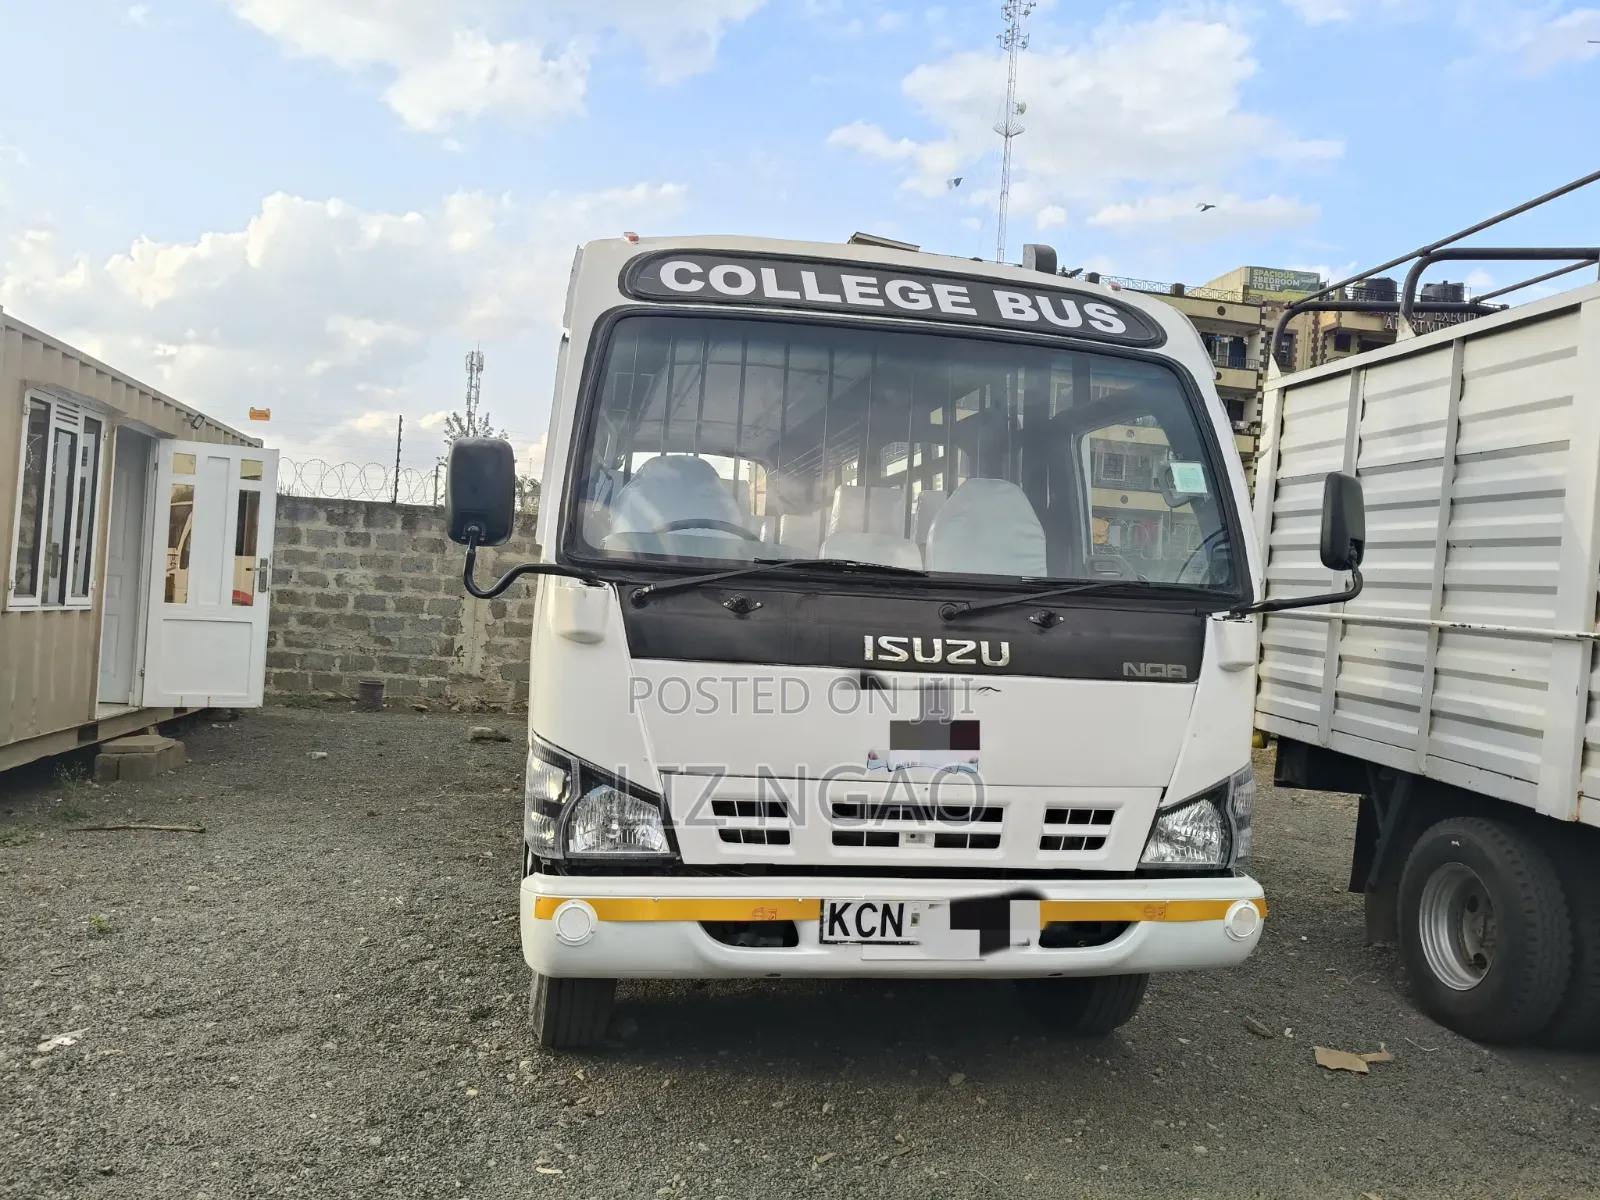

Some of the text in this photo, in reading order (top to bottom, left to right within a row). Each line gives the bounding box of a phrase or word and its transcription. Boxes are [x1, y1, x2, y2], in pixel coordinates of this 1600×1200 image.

[1253, 269, 1294, 279] SPACIOUS
[1253, 282, 1264, 290] TO
[659, 260, 1127, 334] COLLEGE BUS
[863, 634, 1010, 667] ISUZU
[1122, 662, 1188, 678] NQR
[828, 902, 904, 938] KCN
